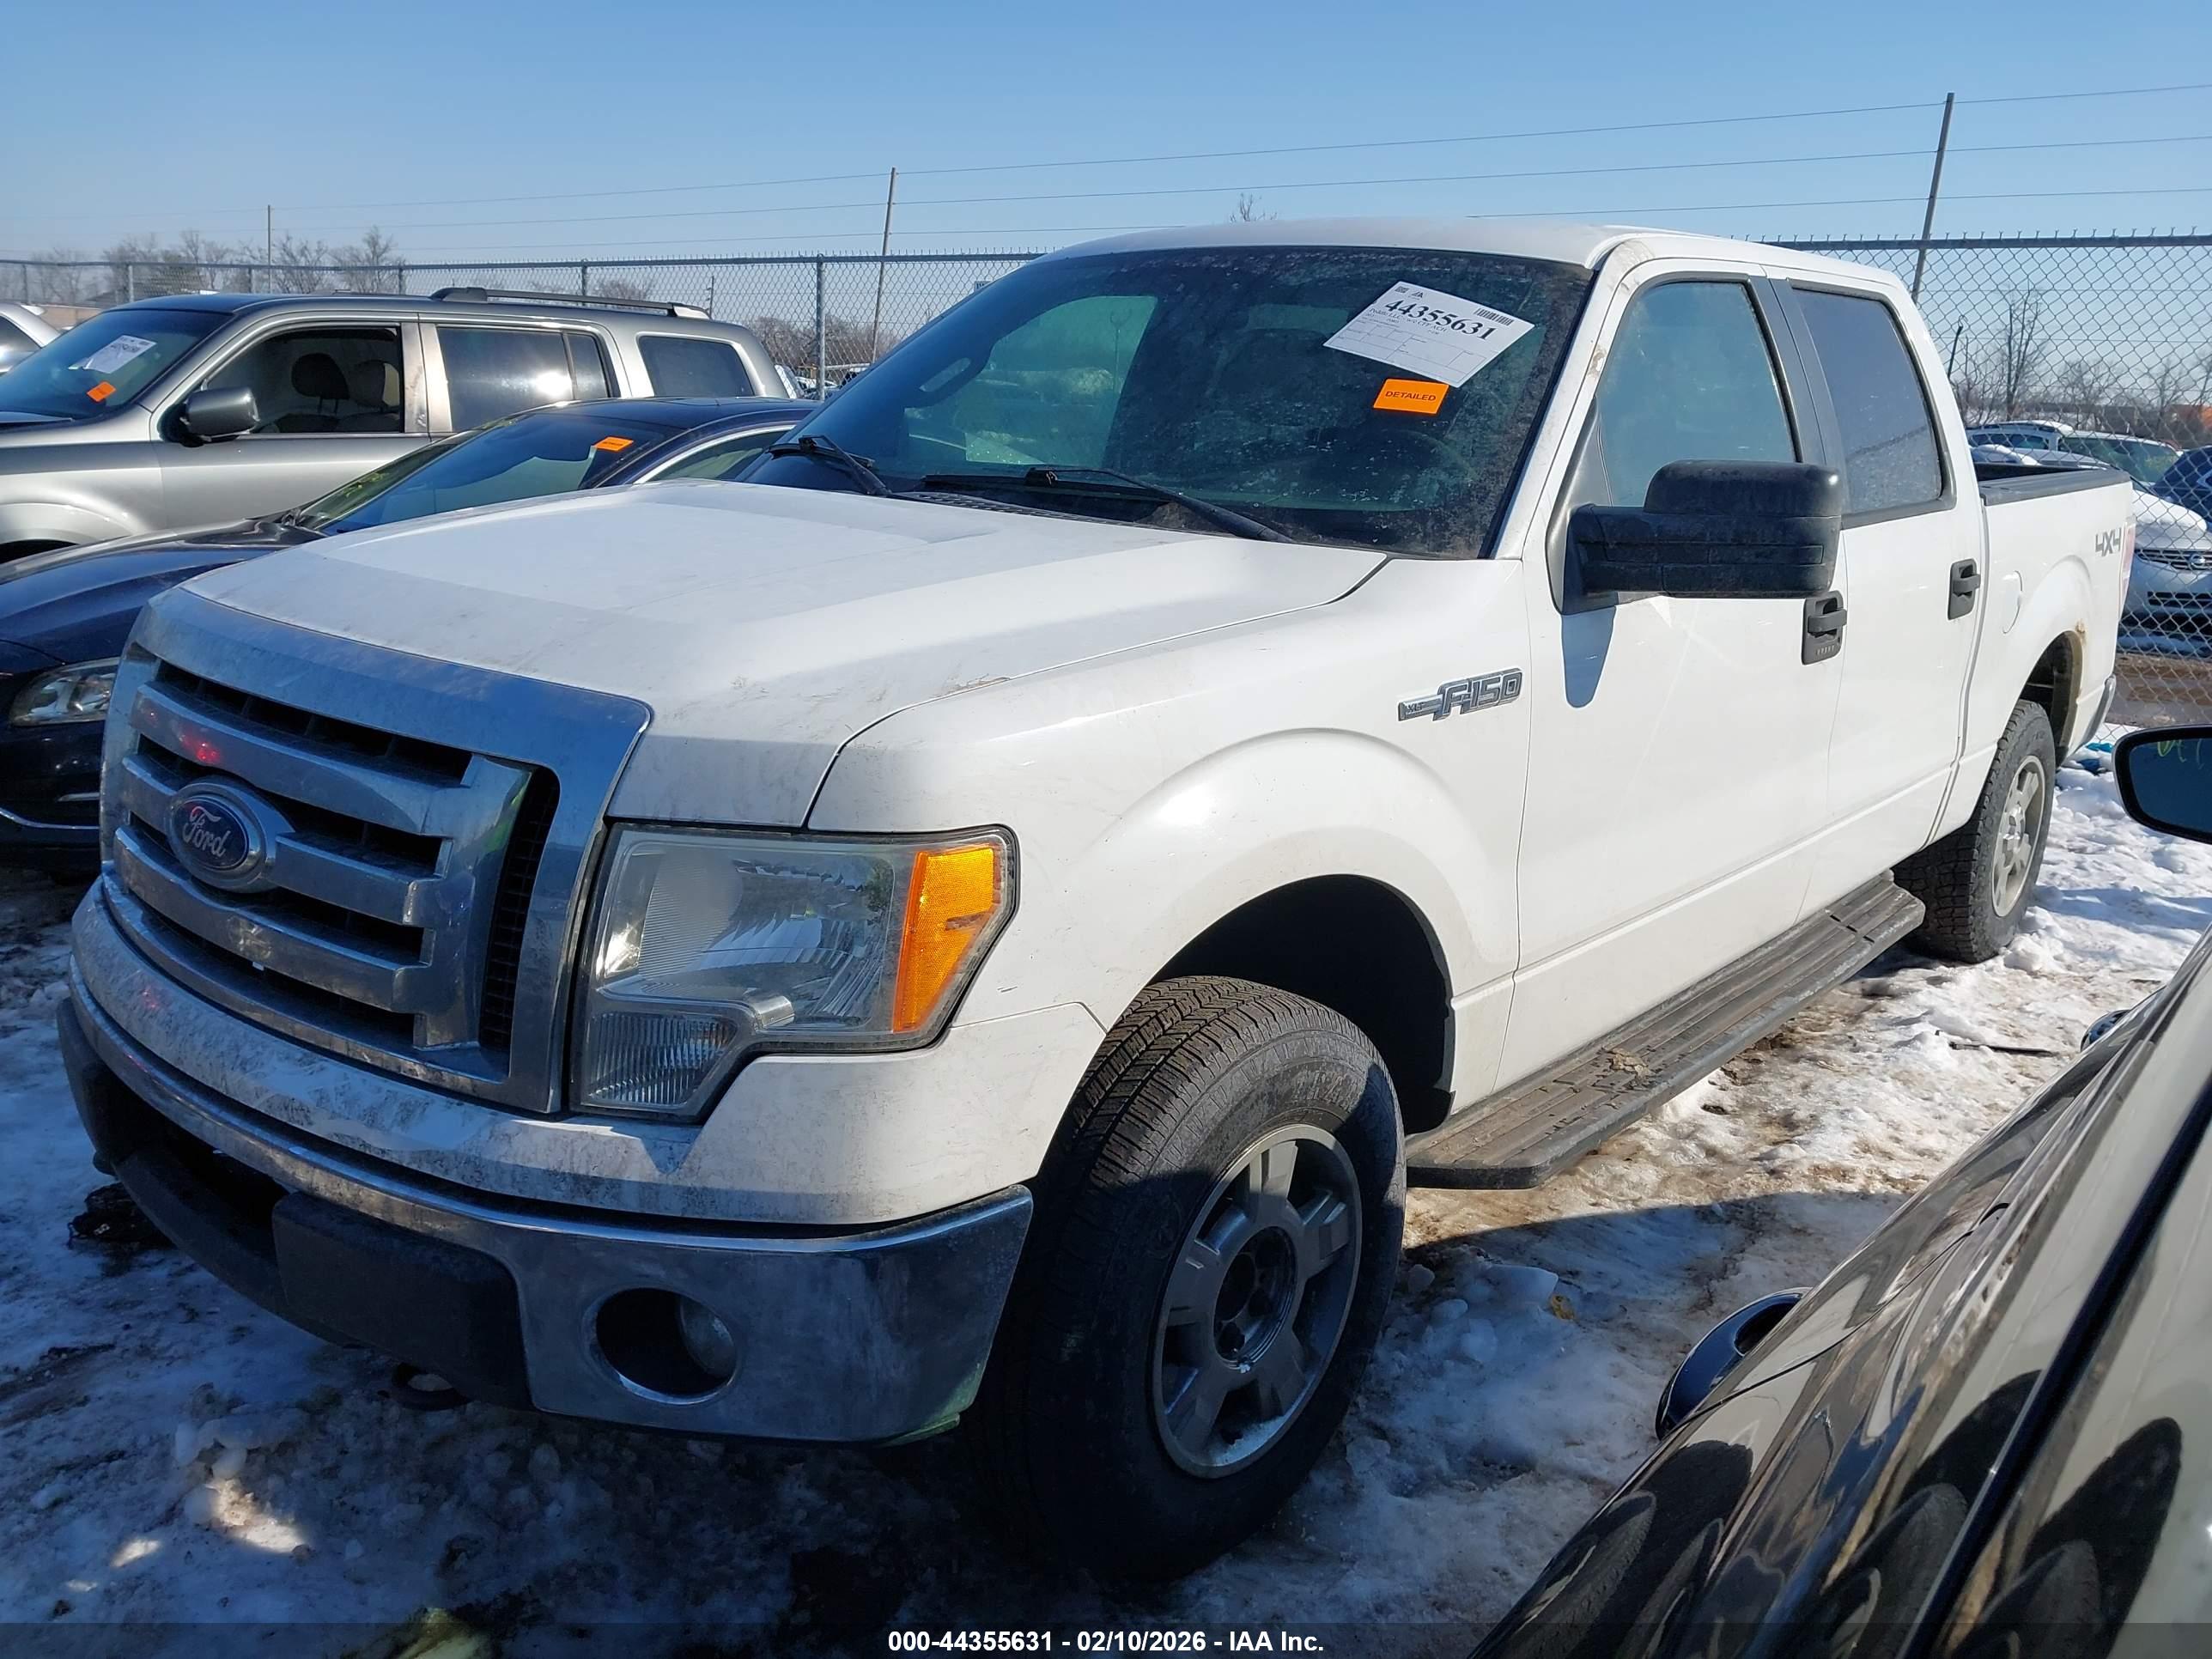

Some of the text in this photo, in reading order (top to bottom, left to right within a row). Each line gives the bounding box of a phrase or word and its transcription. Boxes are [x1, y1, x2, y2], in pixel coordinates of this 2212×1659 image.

[1385, 300, 1497, 340] 44355631
[1385, 391, 1437, 402] DETAILED
[182, 805, 232, 858] Ford
